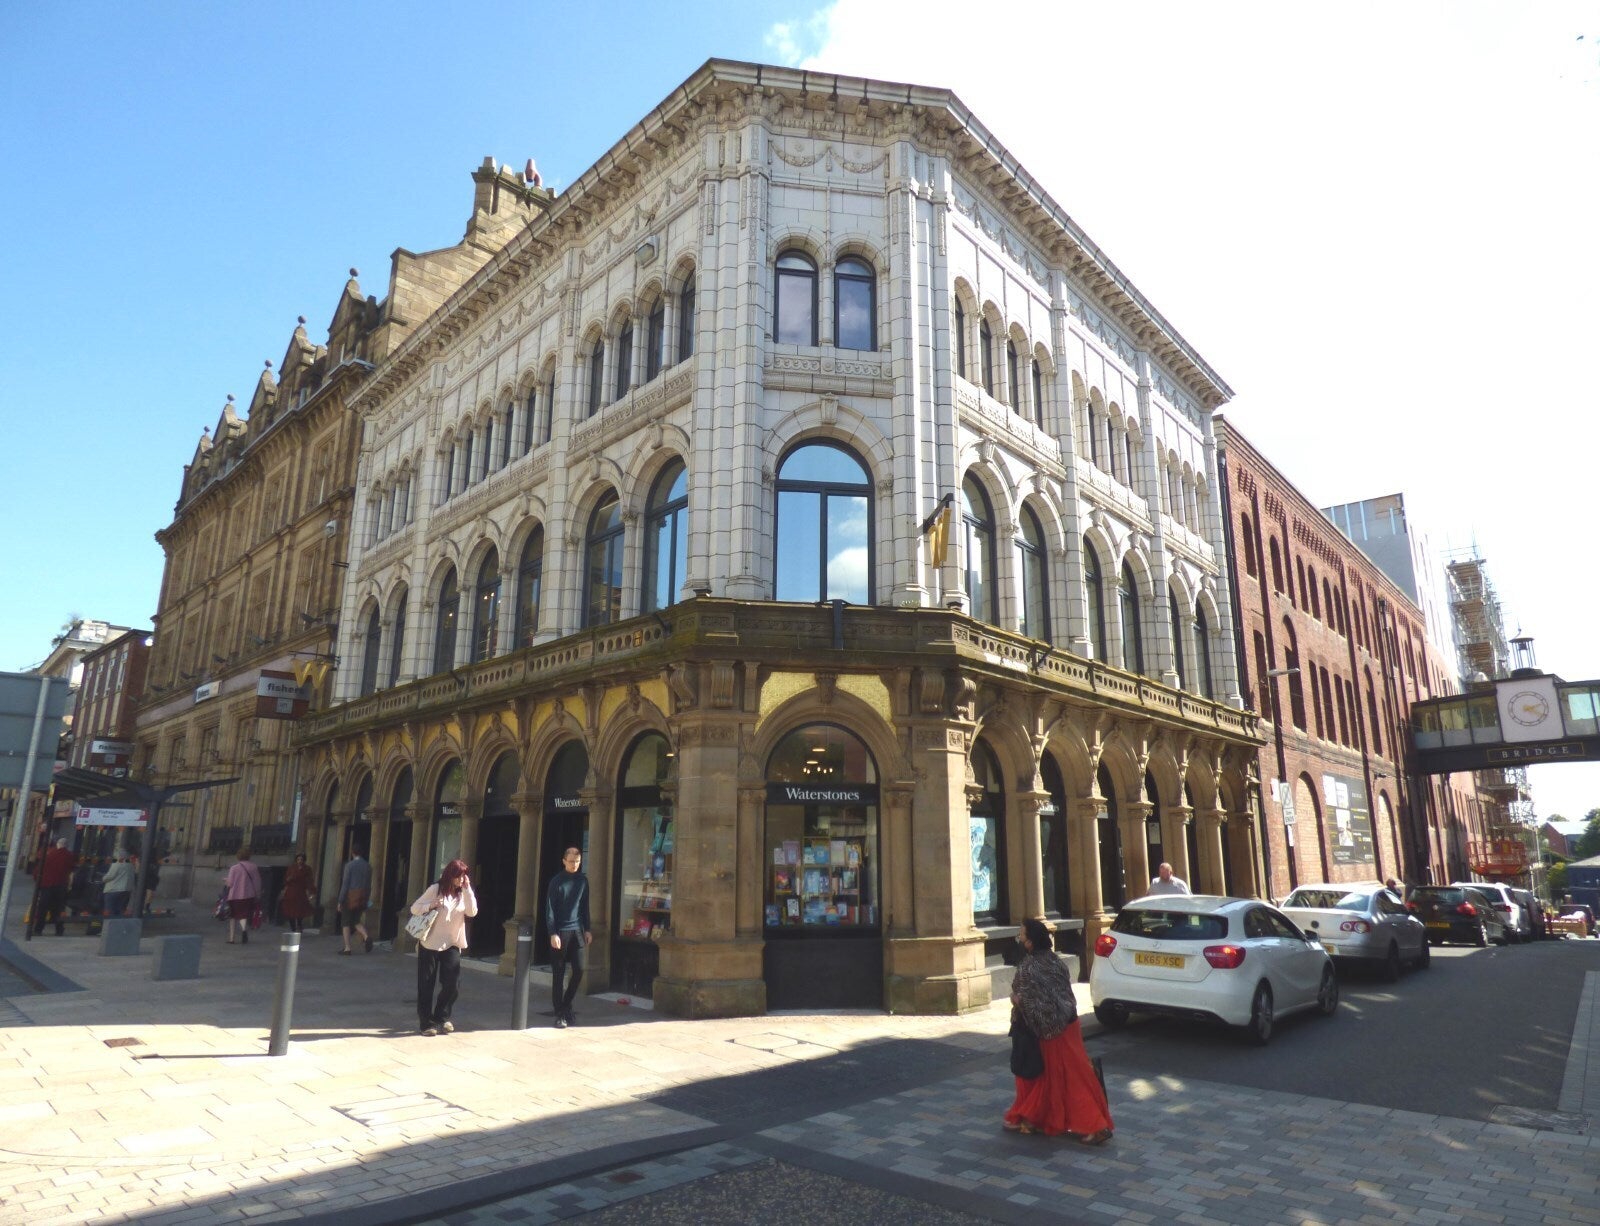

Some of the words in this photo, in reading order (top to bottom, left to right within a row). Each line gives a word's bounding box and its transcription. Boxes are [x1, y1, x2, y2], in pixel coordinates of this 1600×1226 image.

[292, 659, 330, 689] W
[1502, 746, 1569, 759] BRIDGE
[786, 787, 860, 800] Waterstones
[1163, 956, 1181, 967] XSC
